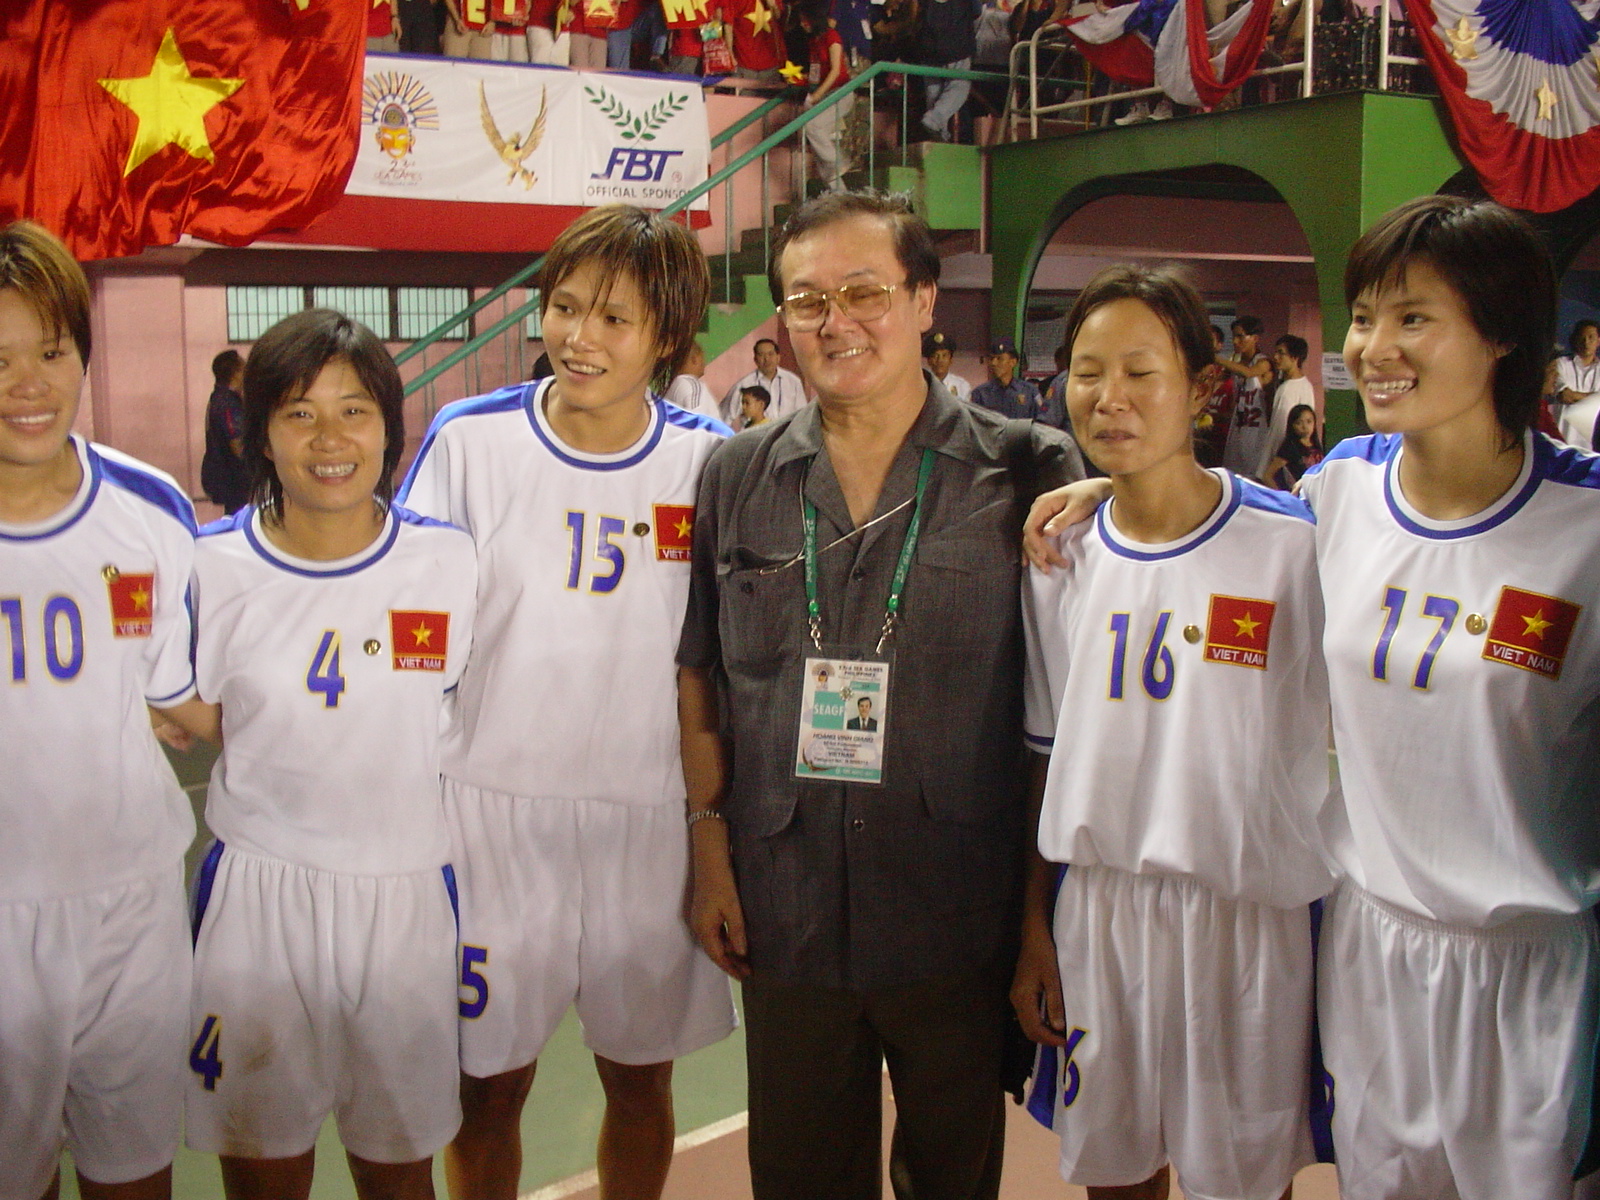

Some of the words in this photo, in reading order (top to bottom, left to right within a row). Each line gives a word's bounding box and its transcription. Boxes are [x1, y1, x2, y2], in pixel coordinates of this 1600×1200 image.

[587, 186, 637, 198] OFFICIAL
[590, 147, 684, 182] FBT
[564, 509, 627, 596] 15
[662, 549, 683, 560] VIET
[0, 593, 85, 687] 10
[399, 658, 421, 669] VIET
[423, 658, 442, 669] NAM
[1107, 609, 1175, 702] 16
[1212, 648, 1238, 661] VIET
[1242, 653, 1265, 666] NAM
[1370, 584, 1463, 691] 17
[1492, 644, 1525, 663] VIET
[1526, 654, 1557, 673] NAM
[304, 628, 347, 710] 4
[190, 1013, 222, 1093] 4
